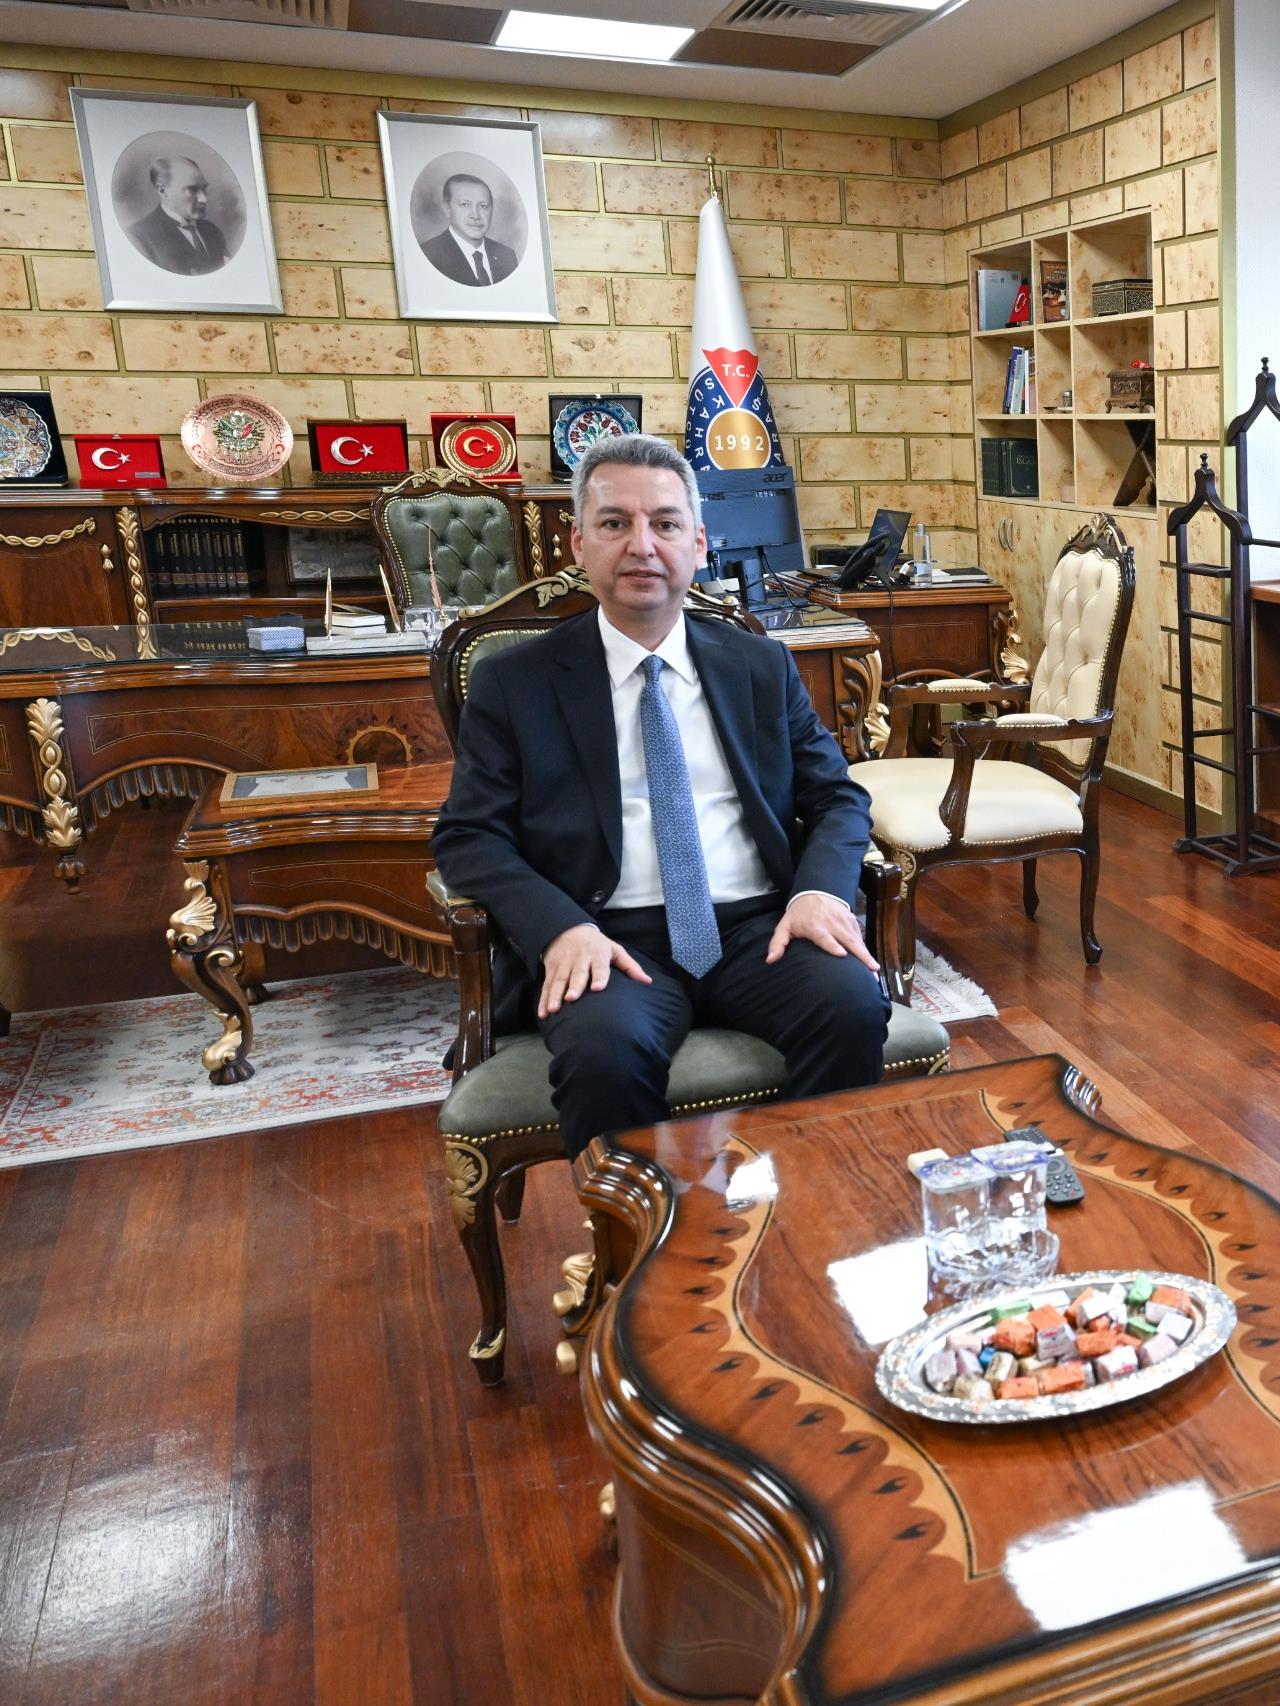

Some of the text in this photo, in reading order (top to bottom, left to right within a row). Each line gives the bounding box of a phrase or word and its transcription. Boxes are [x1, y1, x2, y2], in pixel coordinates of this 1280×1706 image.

[722, 363, 749, 378] T.C.
[714, 434, 764, 452] 1992
[763, 473, 787, 483] acer
